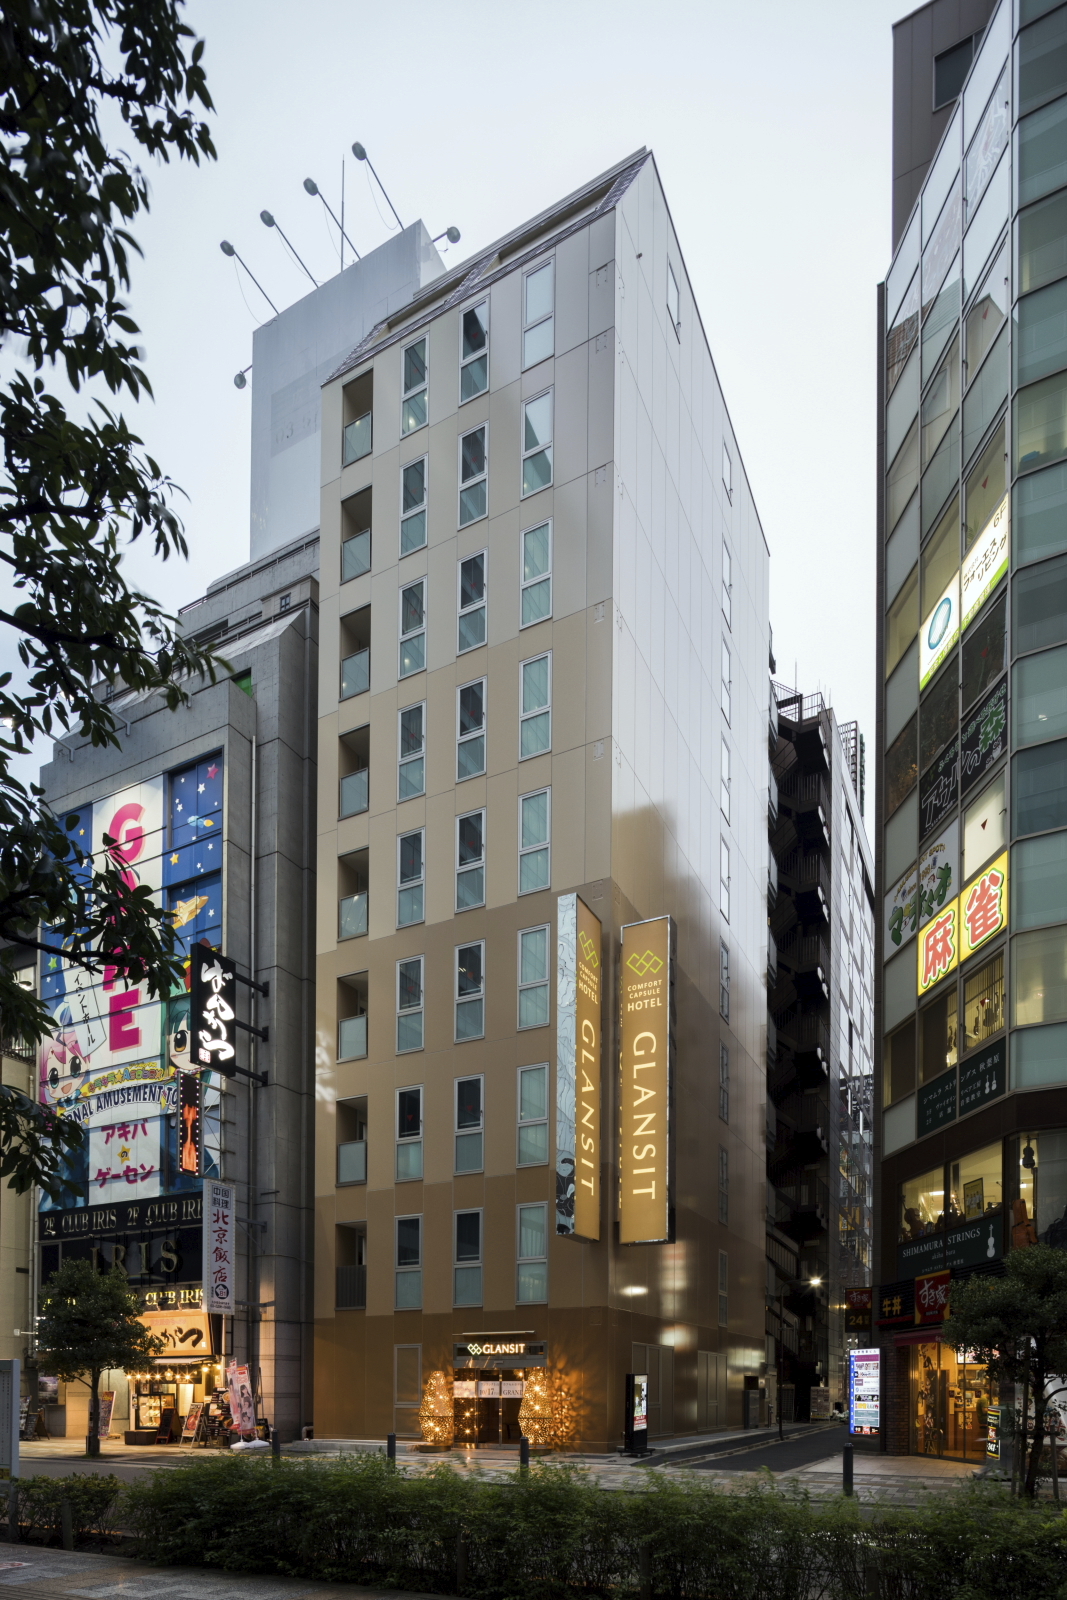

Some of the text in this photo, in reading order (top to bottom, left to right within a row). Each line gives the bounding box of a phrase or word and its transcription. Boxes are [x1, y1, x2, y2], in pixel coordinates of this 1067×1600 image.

[993, 503, 1007, 528] 6F
[978, 531, 1007, 582] リビング
[922, 870, 1002, 988] 麻雀
[578, 961, 598, 983] COMFORT
[579, 970, 598, 991] CAPSULE
[578, 981, 598, 1004] HOTEL
[627, 979, 662, 992] COMFORT
[629, 987, 660, 999] CAPSULE
[74, 973, 96, 1047] イベントホール
[627, 997, 662, 1012] HOTEL
[979, 1052, 1000, 1072] 秋葉原
[97, 1084, 163, 1112] AMUSEMENT
[581, 1018, 596, 1196] GLANSIT
[632, 1031, 656, 1200] GLANSIT
[101, 1118, 148, 1145] アキバ
[121, 1150, 128, 1158] の
[95, 1163, 155, 1188] ゲーセン
[212, 1197, 229, 1209] 料理
[213, 1186, 230, 1199] 中国
[62, 1212, 88, 1233] CLUB
[92, 1208, 117, 1231] IRIS
[127, 1207, 139, 1226] 2F
[147, 1201, 177, 1223] CLUB
[182, 1198, 203, 1220] IRI
[212, 1208, 230, 1284] 北京飯店
[902, 1227, 981, 1258] SHIMAMURA STRINGS
[90, 1240, 178, 1276] IRIS
[882, 1295, 902, 1317] 牛丼
[918, 1279, 948, 1309] すき家
[482, 1343, 526, 1354] GLANSIT
